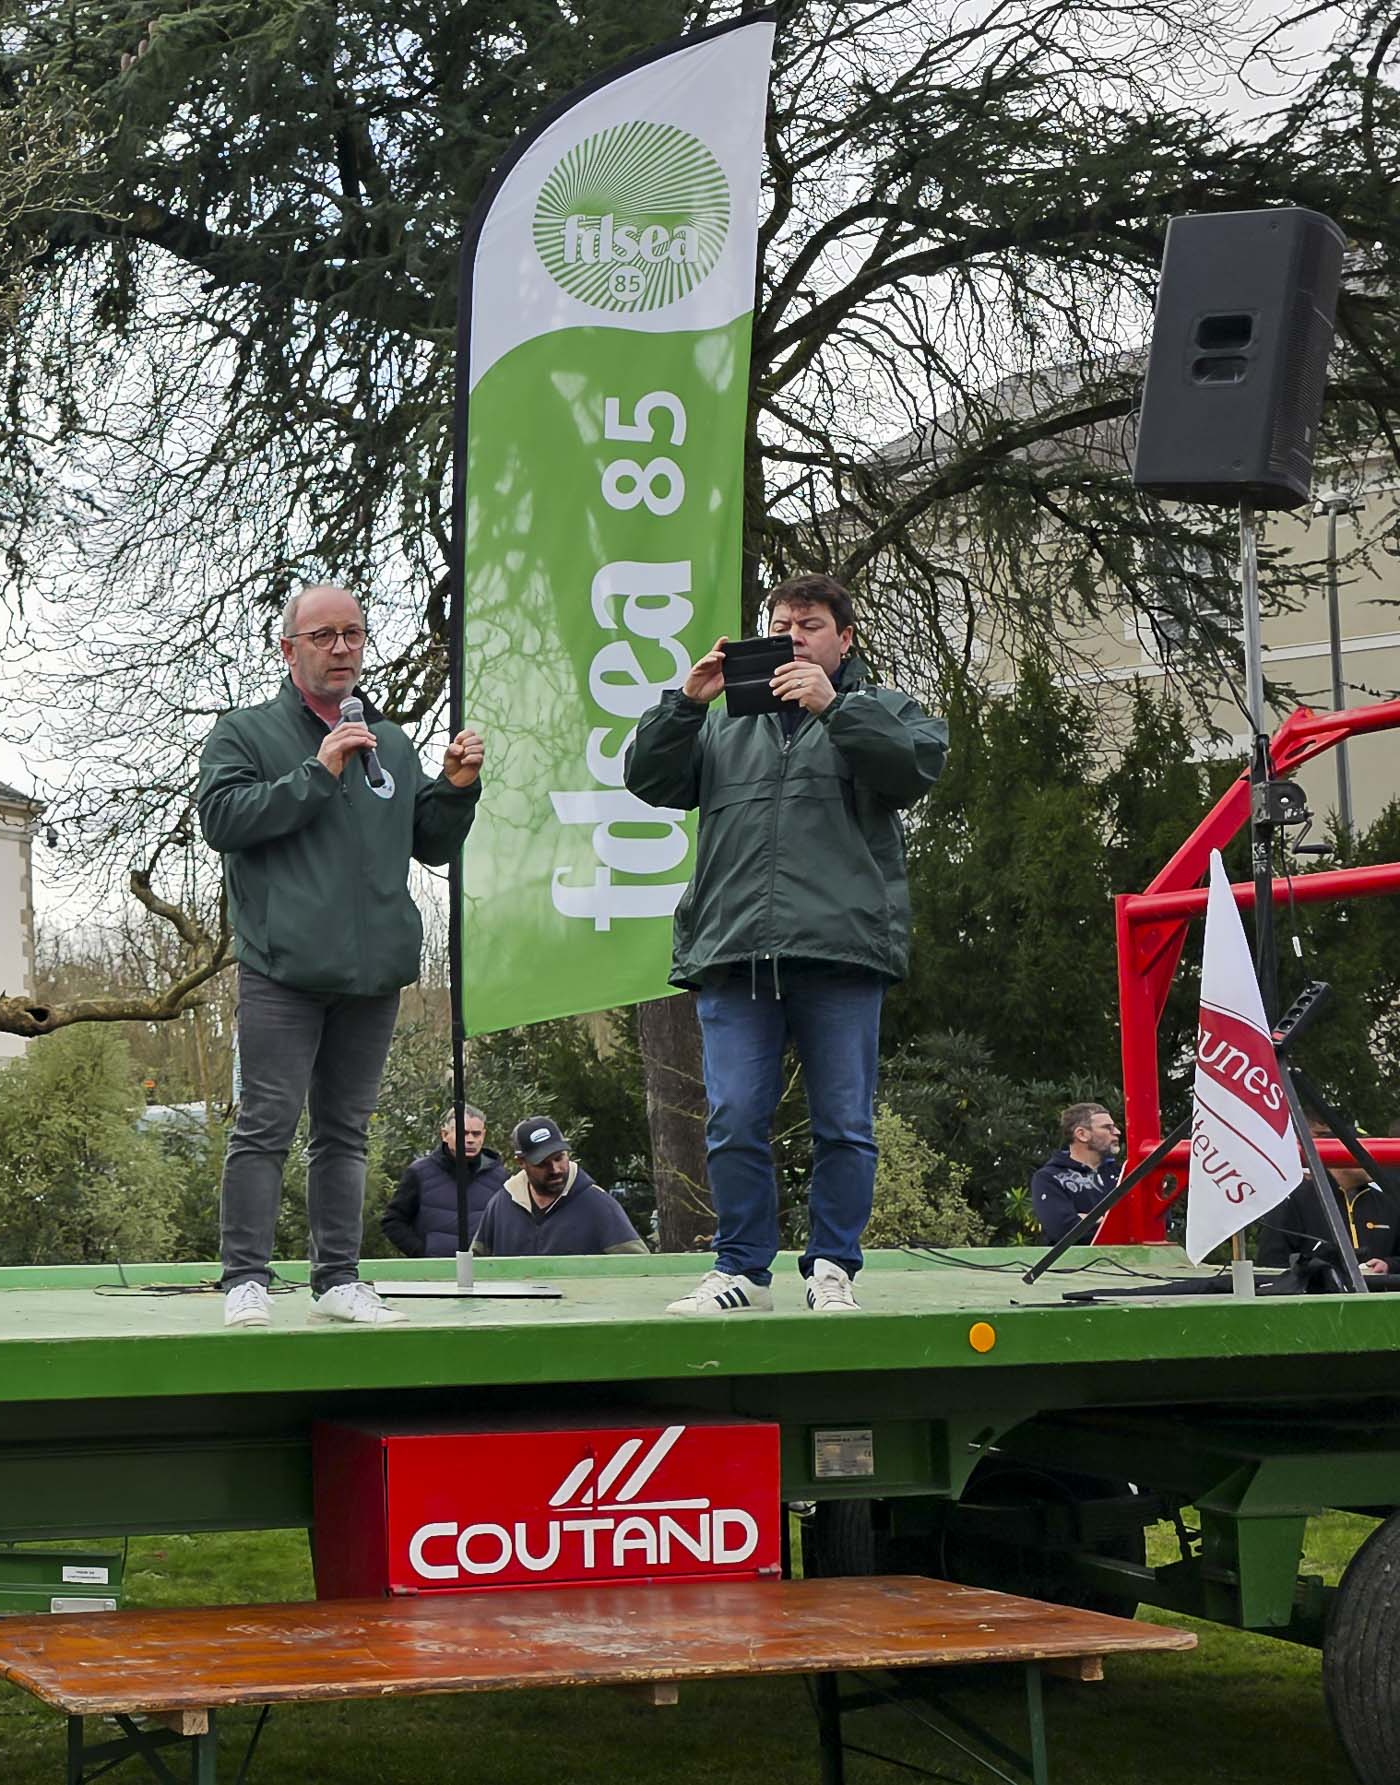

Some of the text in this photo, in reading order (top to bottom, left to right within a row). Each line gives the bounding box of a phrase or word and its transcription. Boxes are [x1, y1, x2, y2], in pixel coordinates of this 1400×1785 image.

[561, 212, 700, 264] fdsea
[614, 275, 641, 293] 85
[600, 390, 687, 517] 85
[1197, 1022, 1284, 1110] unes
[409, 1508, 760, 1580] COUTAND
